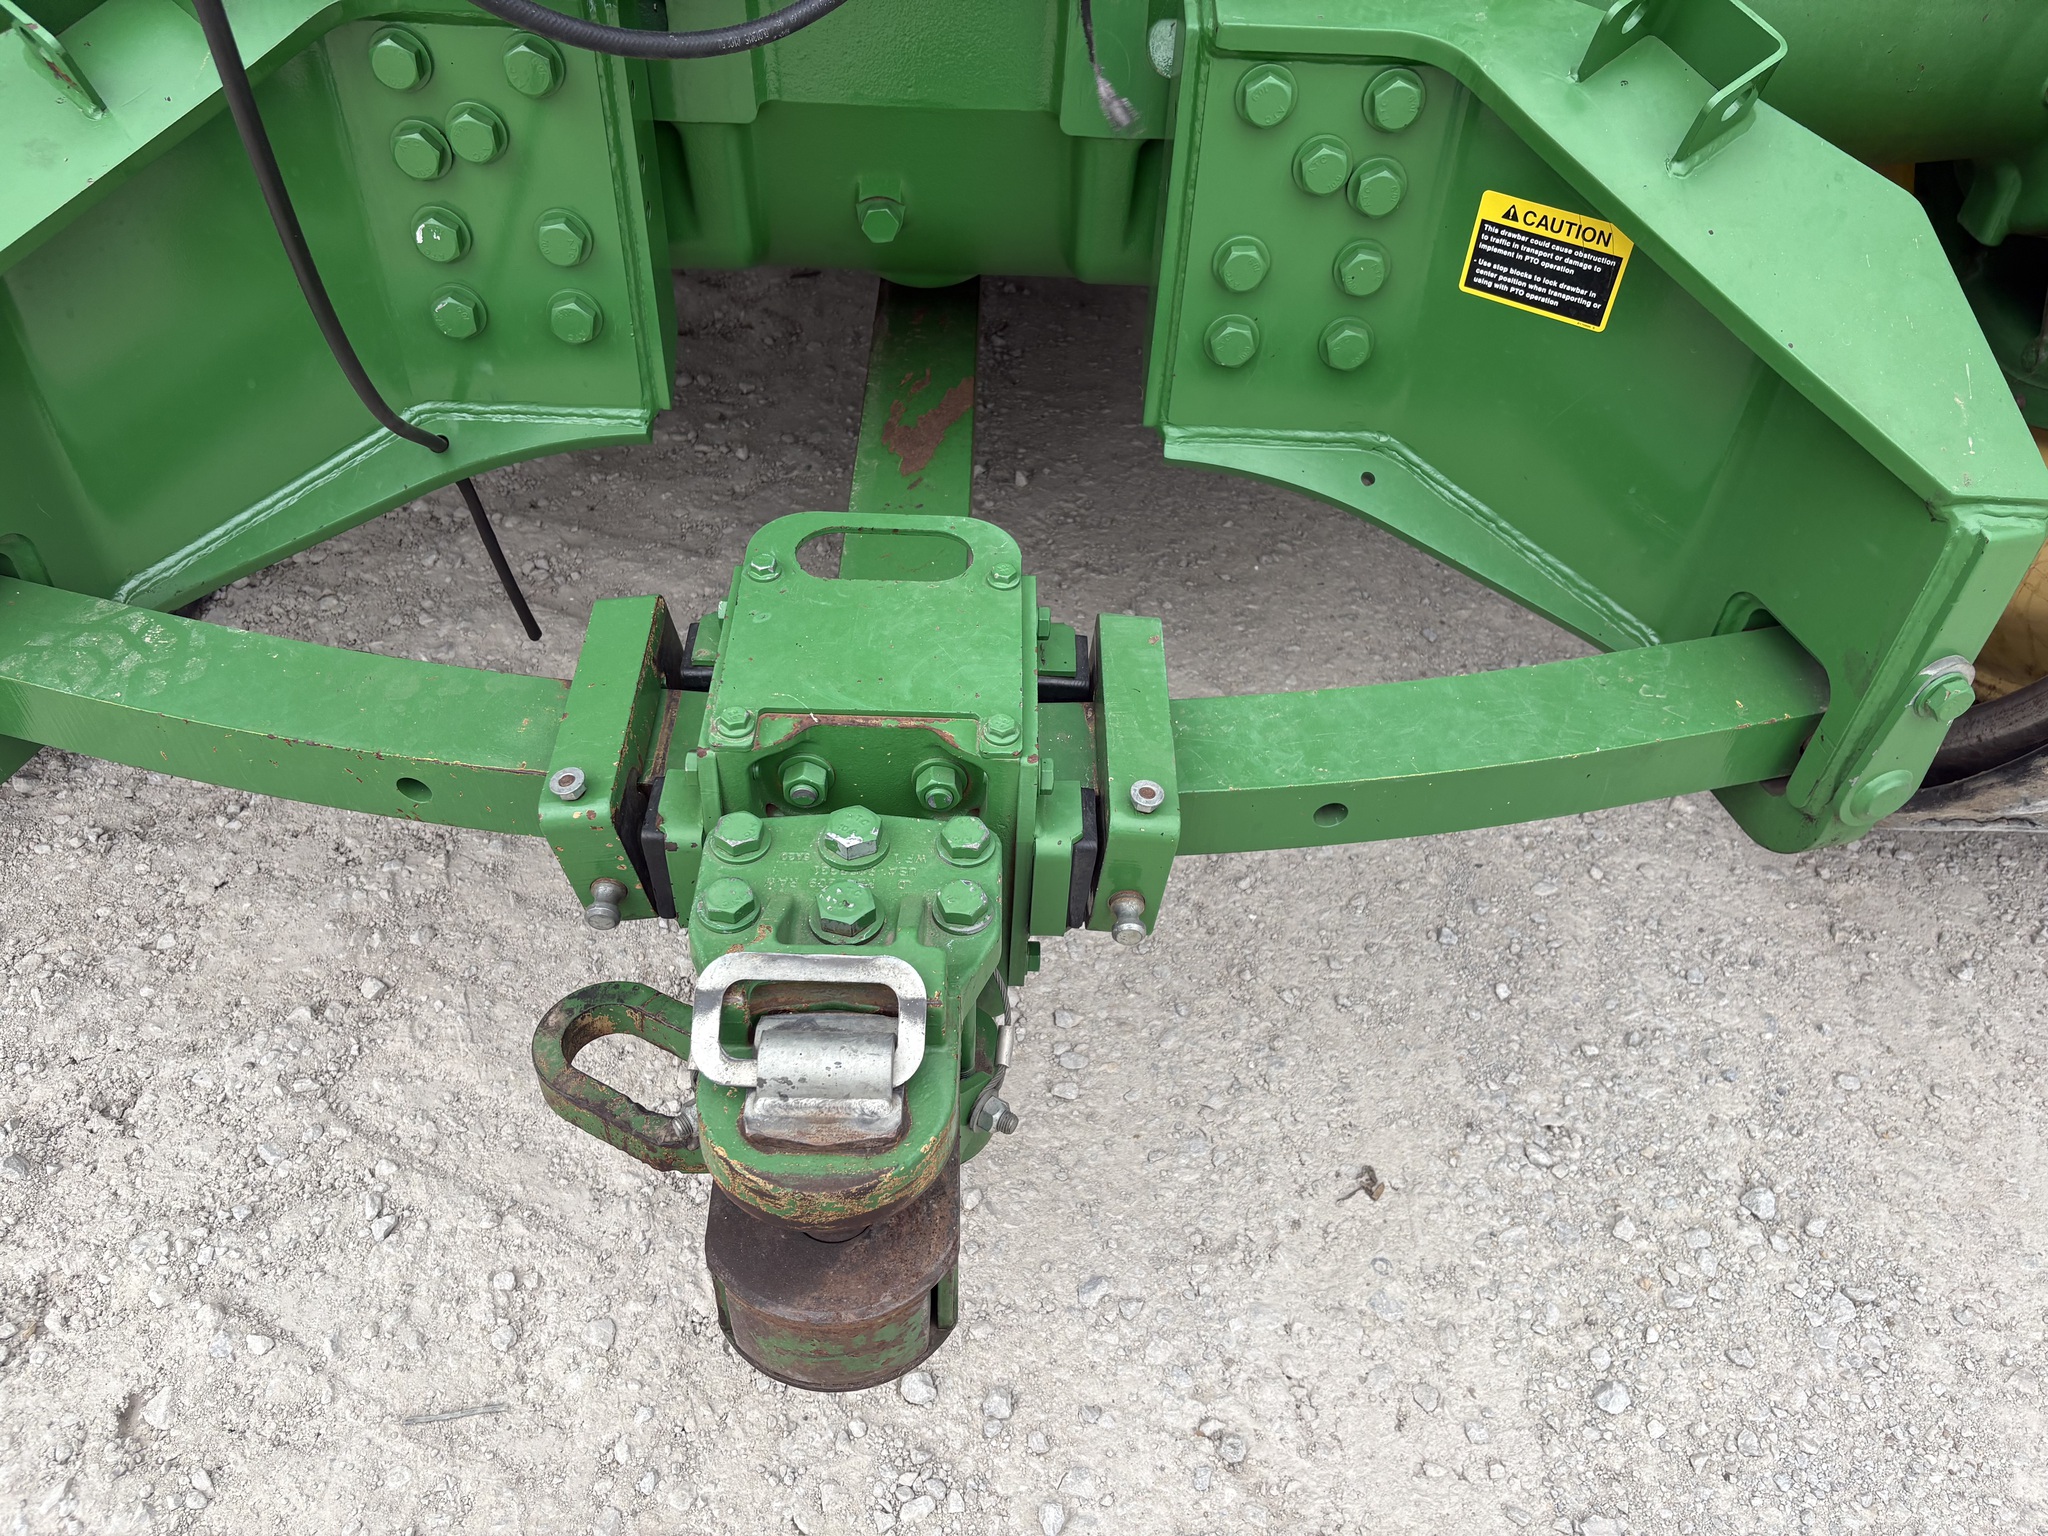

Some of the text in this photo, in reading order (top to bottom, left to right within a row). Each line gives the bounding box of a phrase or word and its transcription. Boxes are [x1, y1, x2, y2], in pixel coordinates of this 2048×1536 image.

[1484, 223, 1616, 266] This drawbar could cause obstruction
[1523, 210, 1613, 248] CAUTION
[1478, 241, 1574, 275] implement in PTO operation
[1481, 232, 1489, 240] to
[1489, 235, 1511, 247] traffic
[1511, 241, 1519, 249] in
[1520, 244, 1554, 259] transport
[1563, 256, 1592, 270] damage
[1473, 276, 1559, 306] using with PTO operation
[1475, 267, 1498, 278] center
[1497, 274, 1527, 287] position
[1527, 283, 1547, 293] when
[1547, 288, 1592, 308] transporting
[1477, 257, 1492, 267] Use
[1492, 263, 1508, 273] stop
[1509, 267, 1532, 280] blocks
[1533, 274, 1541, 282] to
[1542, 276, 1558, 287] lock
[1558, 282, 1588, 295] drawbar
[1588, 290, 1596, 298] in
